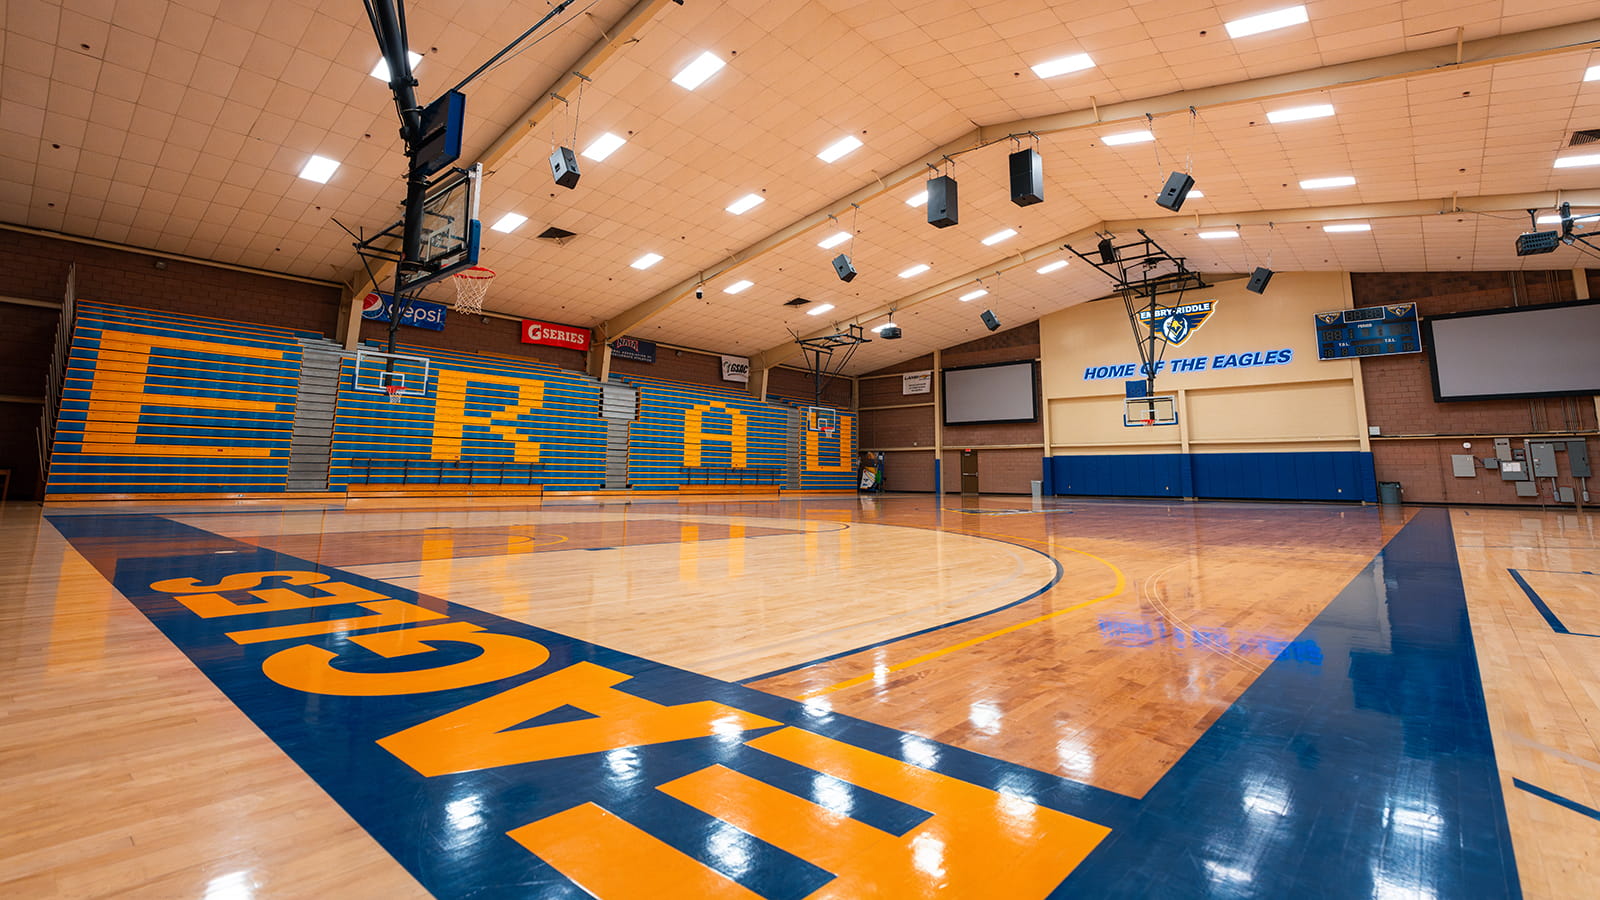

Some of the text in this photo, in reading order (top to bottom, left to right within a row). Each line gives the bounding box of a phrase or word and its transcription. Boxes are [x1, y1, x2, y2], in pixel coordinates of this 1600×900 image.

[542, 329, 584, 344] SERIES
[1084, 349, 1294, 380] HOME OF THE EAGLES
[150, 568, 1112, 900] EAGLES
